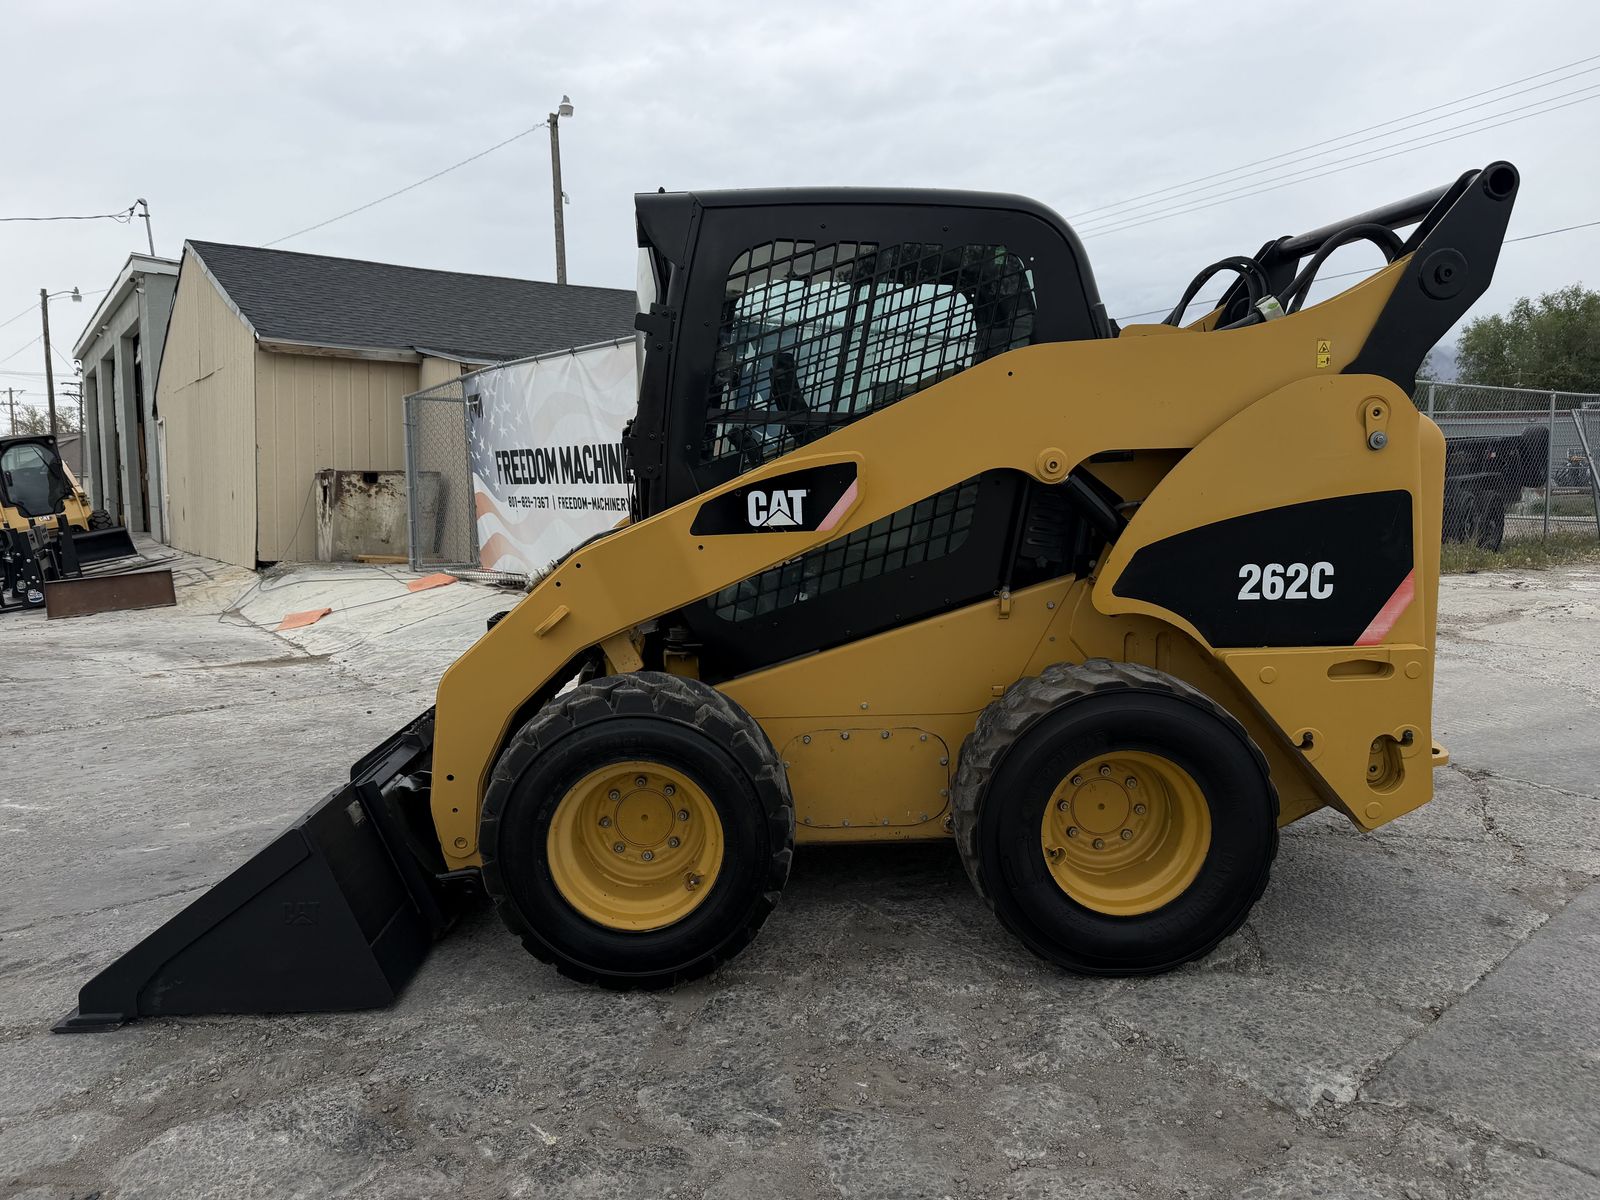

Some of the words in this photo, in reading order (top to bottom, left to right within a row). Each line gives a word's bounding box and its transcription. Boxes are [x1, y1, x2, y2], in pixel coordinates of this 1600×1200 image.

[495, 447, 559, 485] FREEDOM
[747, 489, 807, 527] CAT
[1237, 561, 1335, 601] 262C
